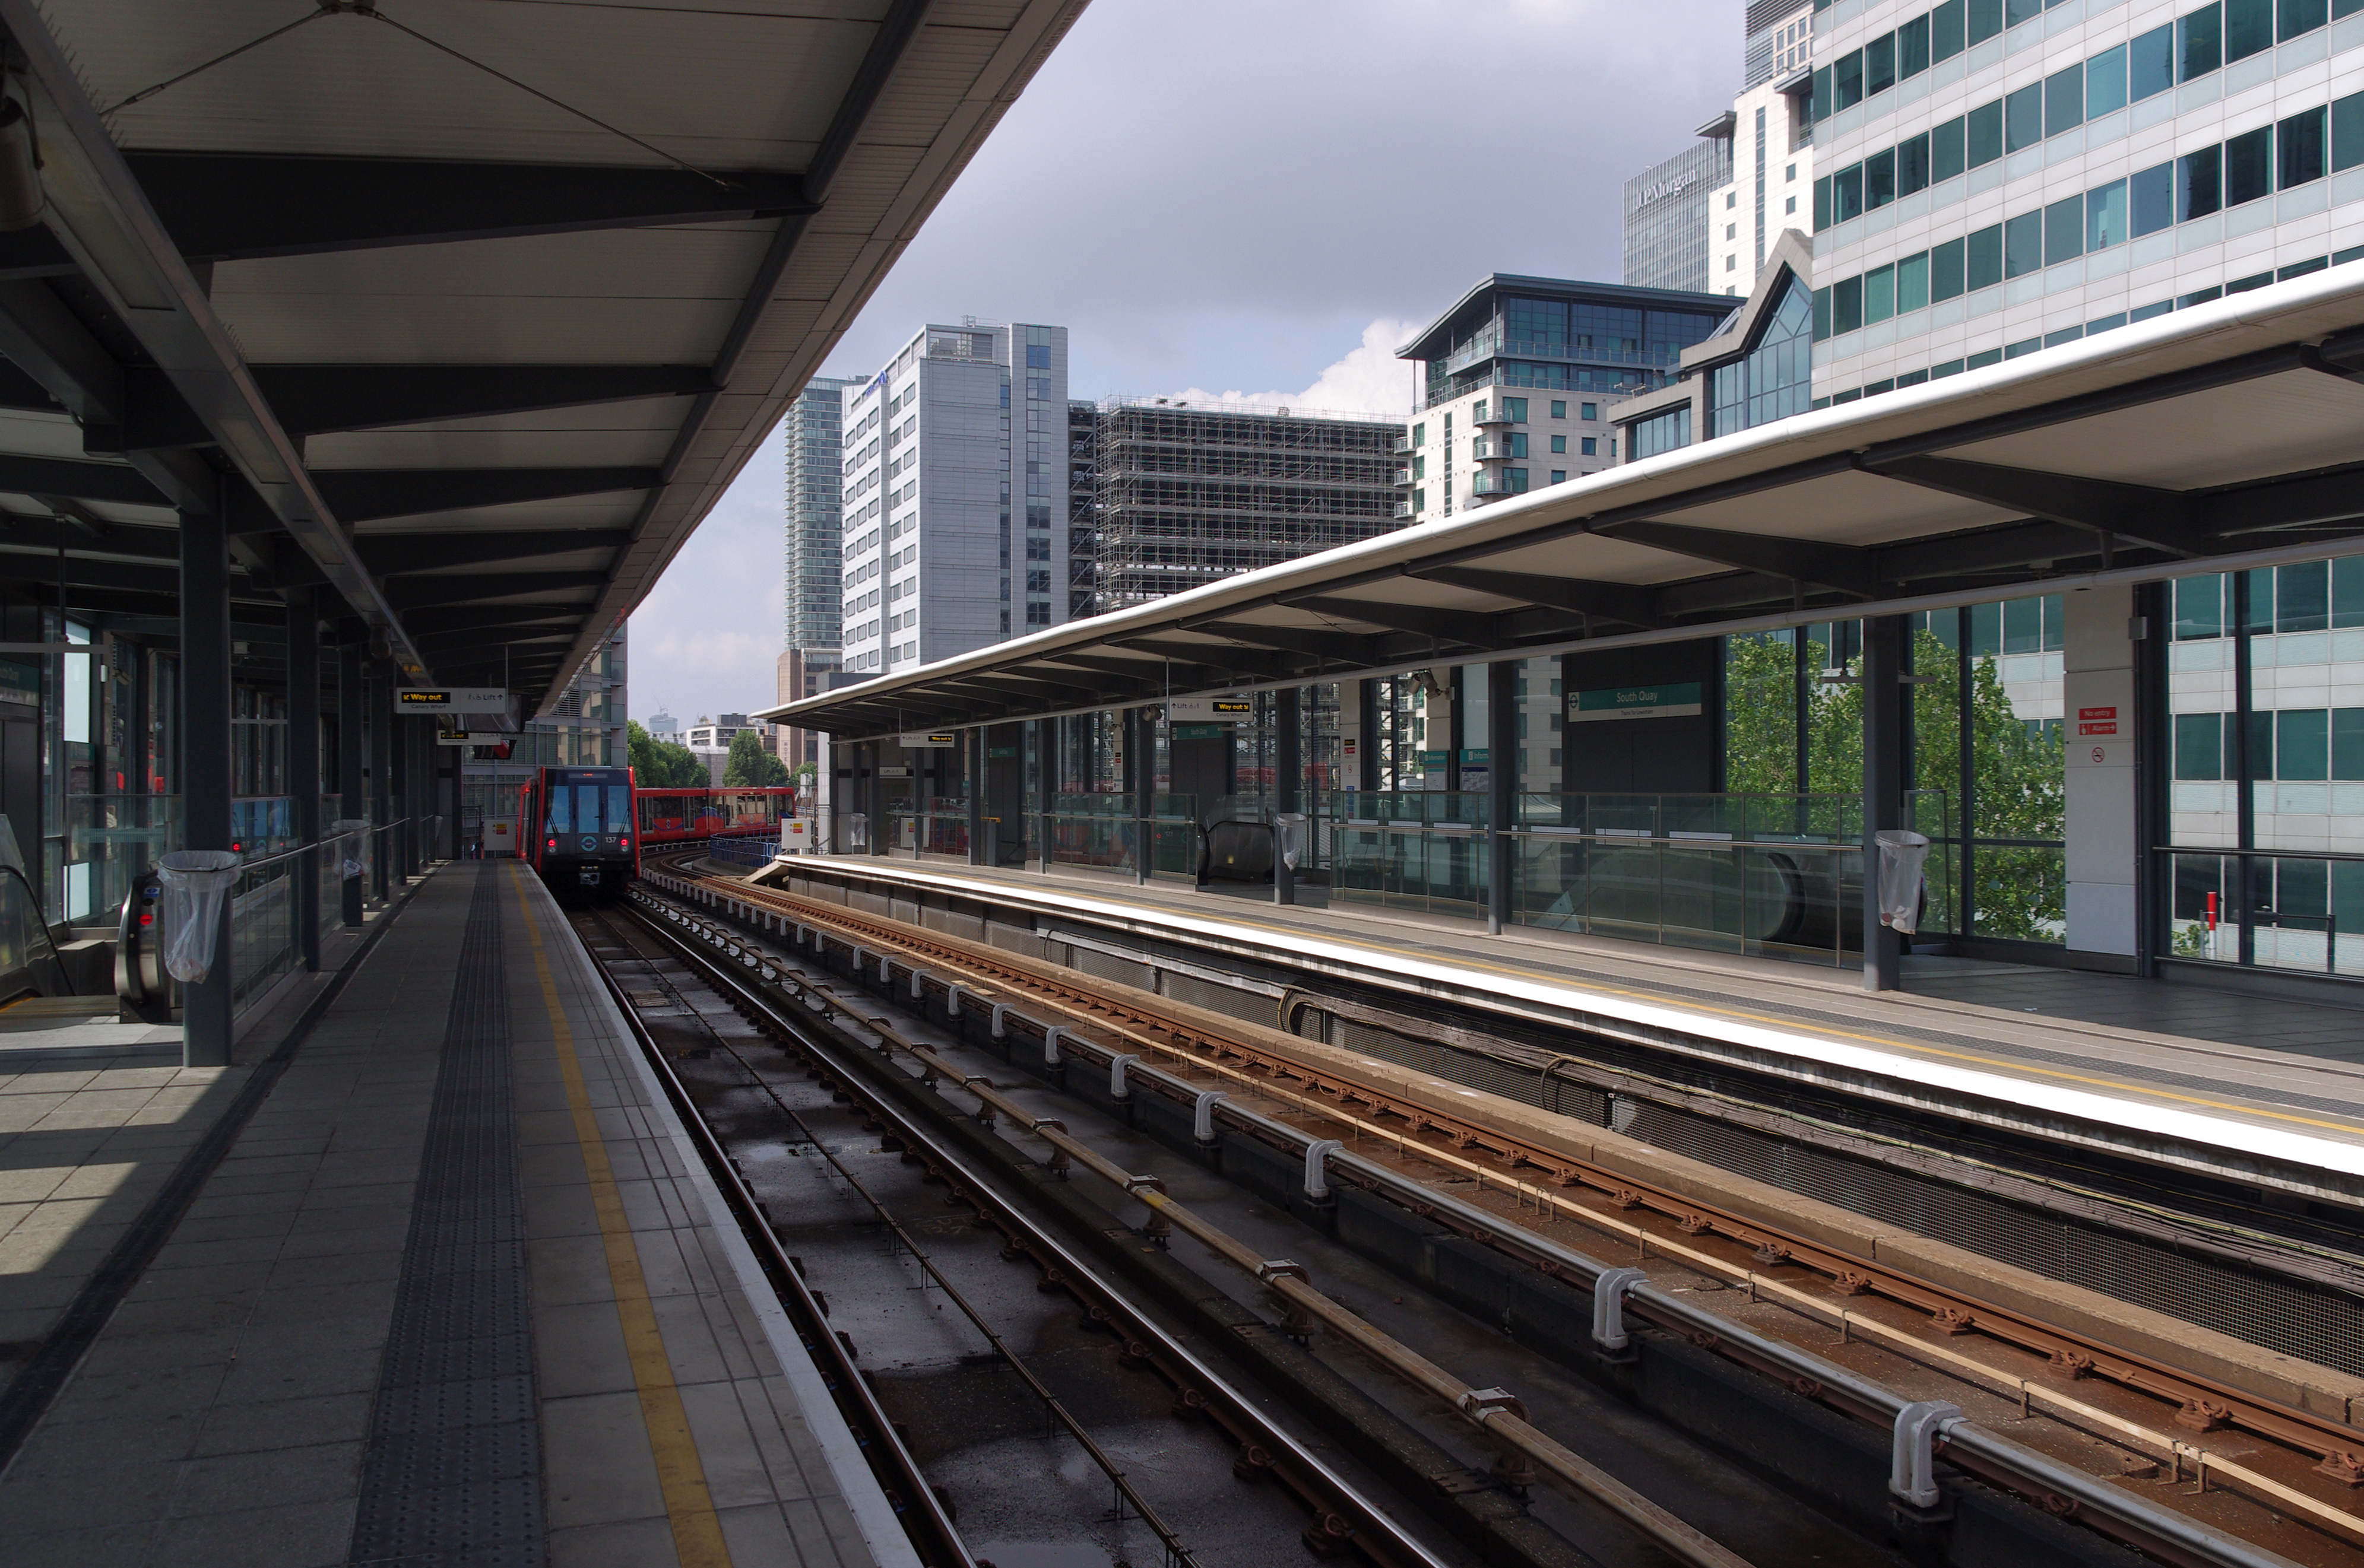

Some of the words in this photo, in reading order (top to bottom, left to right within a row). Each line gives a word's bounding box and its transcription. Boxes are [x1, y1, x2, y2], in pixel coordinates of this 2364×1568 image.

[1636, 170, 1696, 210] J.P.Morgan
[1617, 692, 1637, 703] South
[1639, 691, 1658, 702] Quay
